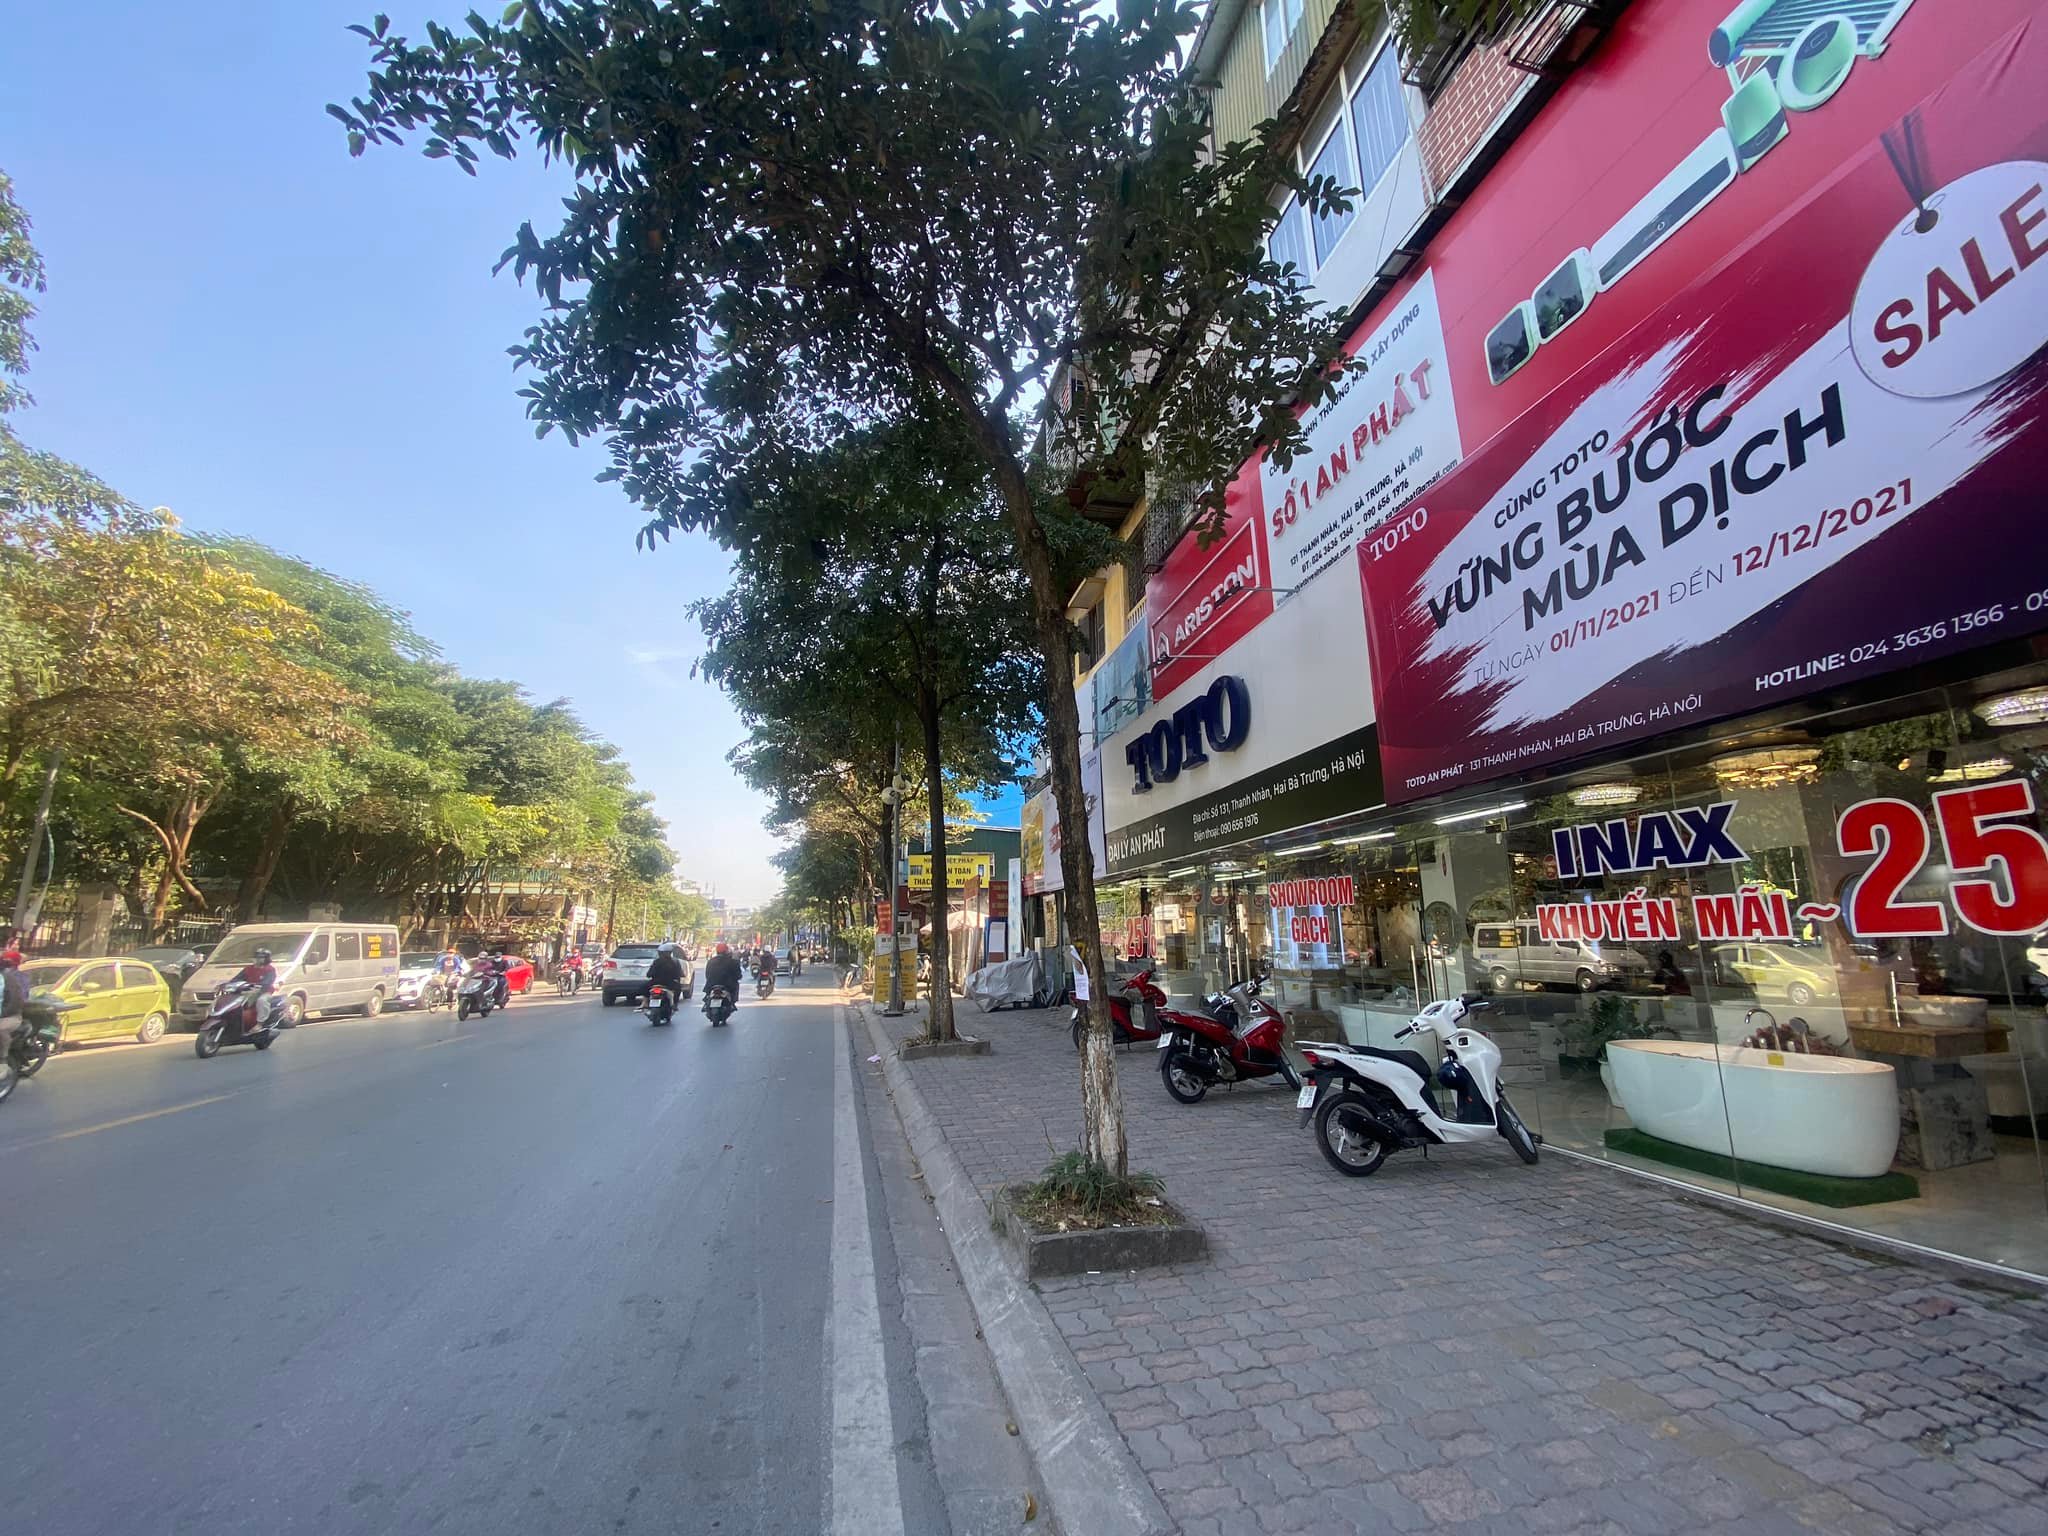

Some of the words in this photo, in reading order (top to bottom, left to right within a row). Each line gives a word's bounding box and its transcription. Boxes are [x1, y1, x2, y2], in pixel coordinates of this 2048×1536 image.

[1874, 182, 2048, 369] SALE
[1370, 338, 1390, 366] XÂY
[1392, 303, 1421, 343] DỰNG
[1272, 477, 1298, 538] SỐ
[1299, 479, 1312, 511] 1
[1315, 441, 1350, 501] AN
[1352, 357, 1431, 462] PHÁT
[1494, 478, 1547, 529] CÙNG
[1550, 429, 1609, 486] TOTO
[1299, 535, 1320, 559] THANH
[1341, 504, 1353, 523] HAI
[1354, 495, 1365, 512] BÀ
[1394, 458, 1407, 478] HÀ
[1408, 445, 1424, 466] NỘI
[1363, 507, 1376, 524] 090
[1377, 493, 1391, 511] 656
[1392, 478, 1409, 500] 1976
[1369, 507, 1428, 561] TOTO
[1427, 521, 1545, 630] VỮNG
[1556, 383, 1733, 546] BƯỚC
[1522, 525, 1647, 632] MÙA
[1658, 381, 1846, 550] DỊCH
[1174, 555, 1254, 648] ARISTON
[1498, 640, 1546, 676] NGÀY
[1550, 590, 1660, 653] 01/11/2021
[1667, 564, 1725, 605] ĐẾN
[1731, 478, 1913, 578] 12/12/2021
[1755, 652, 1846, 691] HOTLINE:
[1849, 640, 1889, 664] 024
[1893, 621, 1947, 651] 3636
[1951, 604, 2005, 634] 1366
[1125, 675, 1251, 795] TOTO
[1405, 774, 1427, 789] TOTO
[1427, 771, 1441, 783] AN
[1440, 762, 1465, 779] PHÁT
[1469, 760, 1481, 771] 131
[1482, 749, 1517, 768] THANH
[1518, 738, 1553, 758] NHÀN,
[1555, 732, 1575, 748] HAI
[1577, 724, 1595, 742] BÀ
[1597, 711, 1647, 736] TRƯNG,
[1649, 701, 1671, 721] HÀ
[1673, 694, 1703, 714] NỘI
[1210, 805, 1219, 819] Số
[1231, 795, 1251, 812] Thanh
[1273, 780, 1287, 797] Hai
[1288, 774, 1299, 791] Bà
[1300, 766, 1330, 786] Trưng,
[1330, 756, 1346, 775] Hà
[1346, 749, 1366, 770] Nội
[1220, 822, 1231, 835] 090
[1232, 818, 1244, 832] 656
[1244, 812, 1259, 828] 1976
[1108, 841, 1120, 865] ĐẠI
[1120, 834, 1129, 860] LÝ
[1130, 836, 1142, 857] AN
[1142, 823, 1166, 852] PHÁT
[1535, 886, 1681, 942] KHUYẾN
[1693, 885, 1795, 942] MÃI
[1836, 777, 2048, 938] 25
[1551, 800, 1751, 880] INAX
[1268, 876, 1355, 909] SHOWROOM
